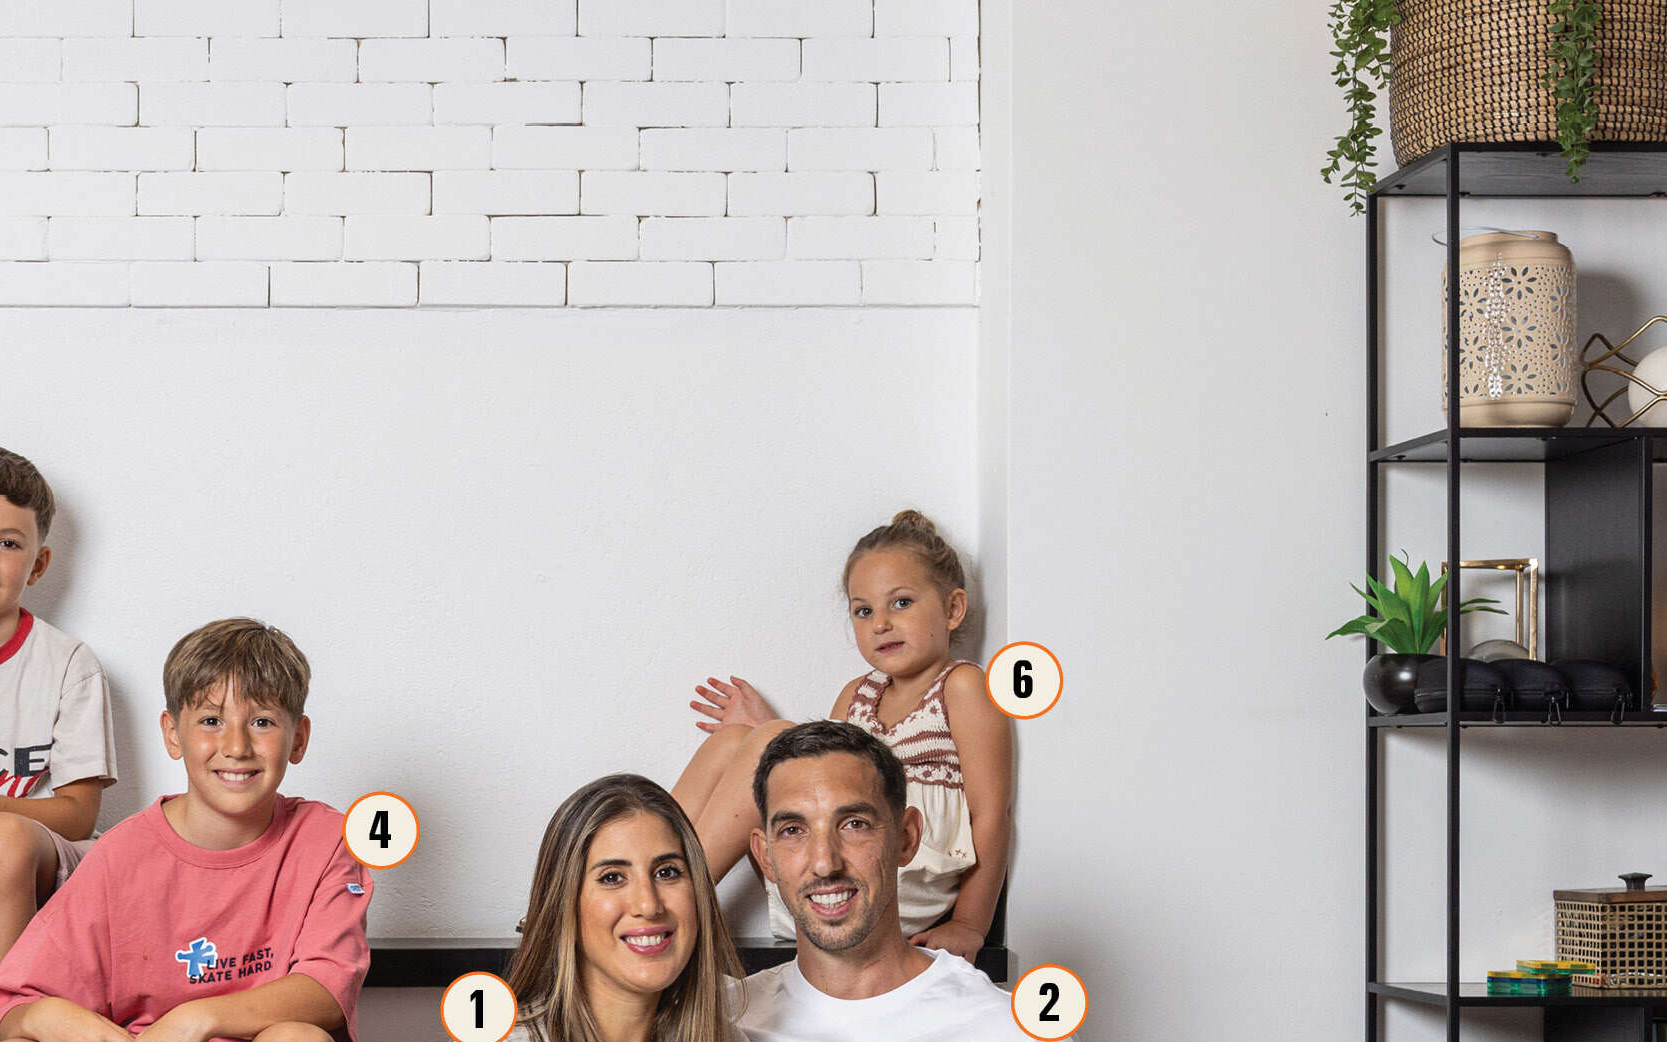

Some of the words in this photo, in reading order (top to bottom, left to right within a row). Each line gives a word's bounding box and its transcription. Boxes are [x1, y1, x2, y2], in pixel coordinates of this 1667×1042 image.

[206, 957, 237, 970] LIVE
[242, 947, 274, 966] FAST,
[189, 970, 233, 985] SKATE
